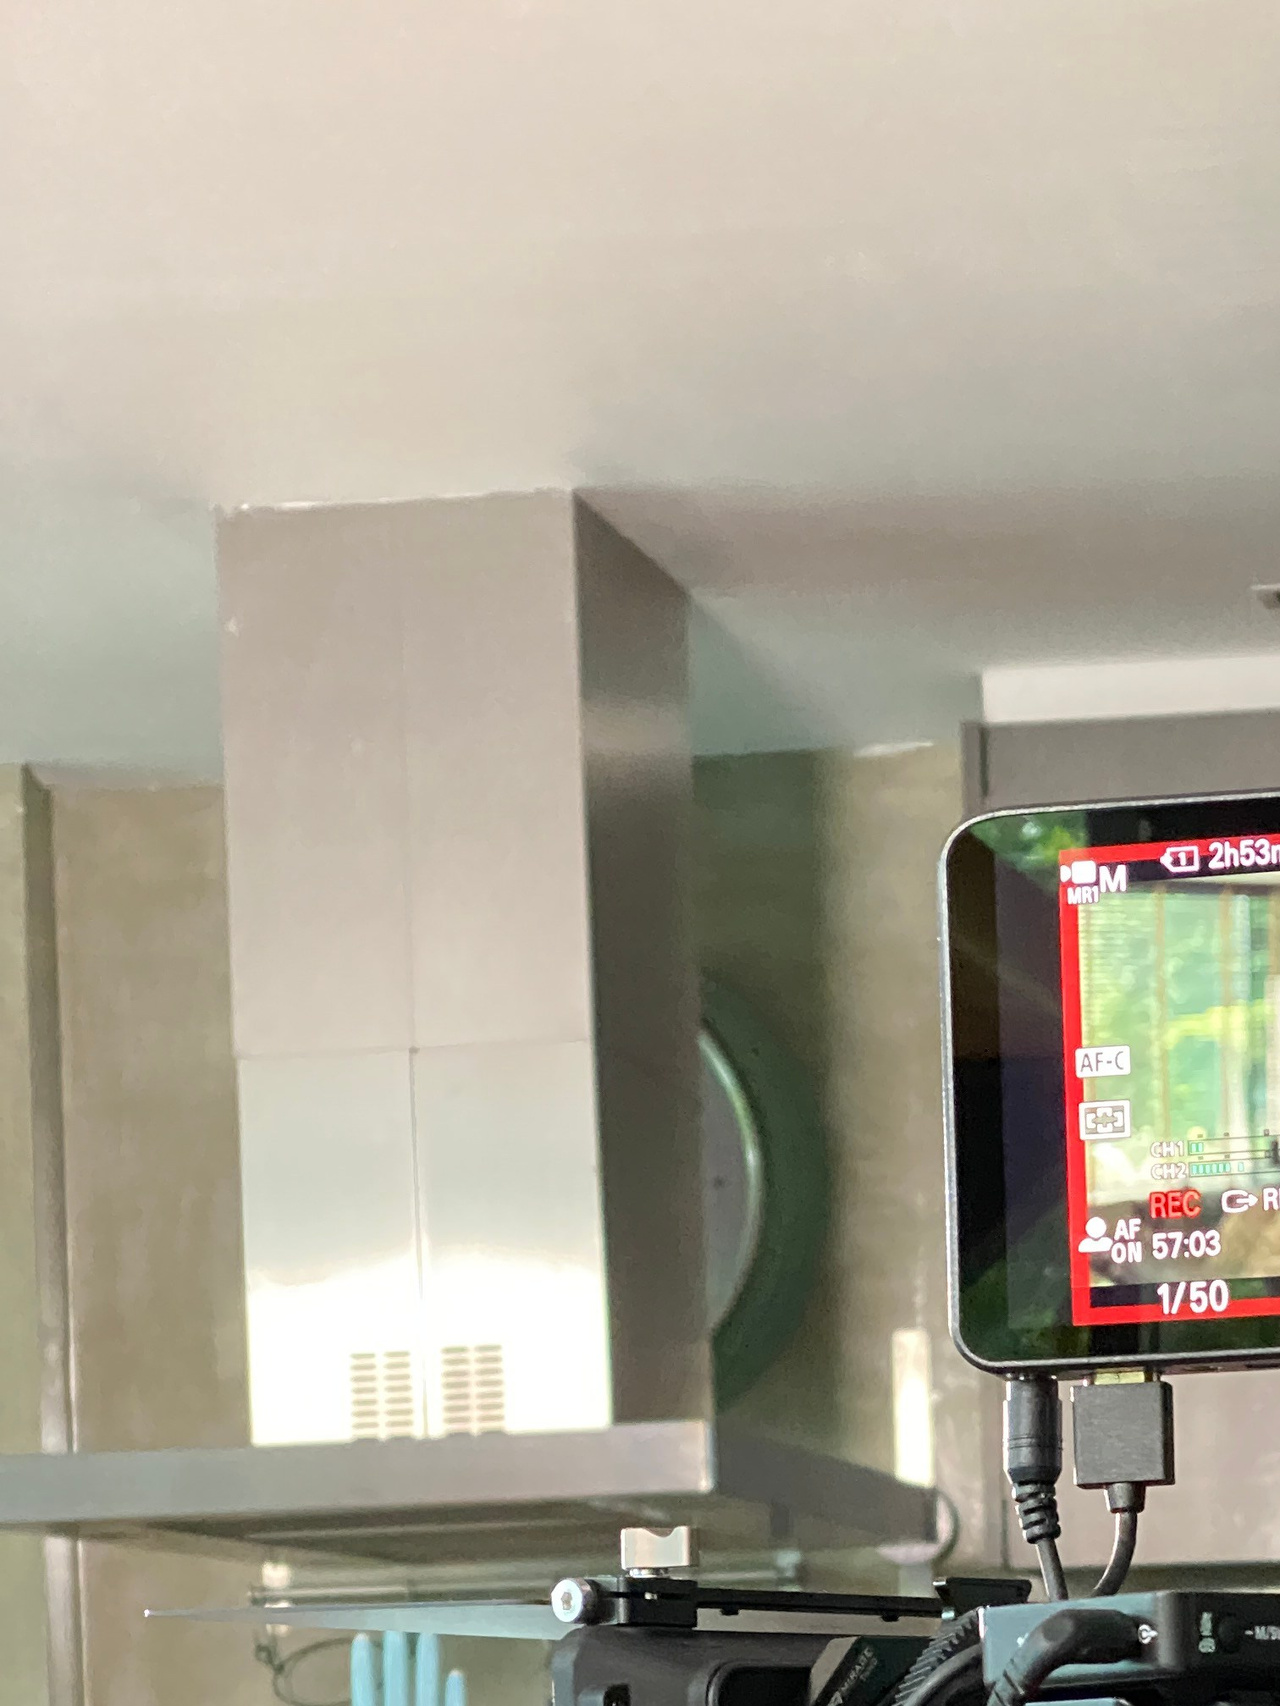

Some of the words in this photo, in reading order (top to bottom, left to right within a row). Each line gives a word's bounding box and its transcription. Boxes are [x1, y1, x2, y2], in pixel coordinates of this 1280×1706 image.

[1100, 864, 1127, 893] M
[1079, 1050, 1125, 1073] AF-C
[1150, 1140, 1185, 1158] CH1
[1150, 1163, 1187, 1180] CH2
[1149, 1189, 1201, 1218] REC
[1114, 1218, 1142, 1241] AF
[1110, 1241, 1142, 1263] ON
[1152, 1229, 1221, 1260] 57:03
[1156, 1279, 1229, 1315] 1/50
